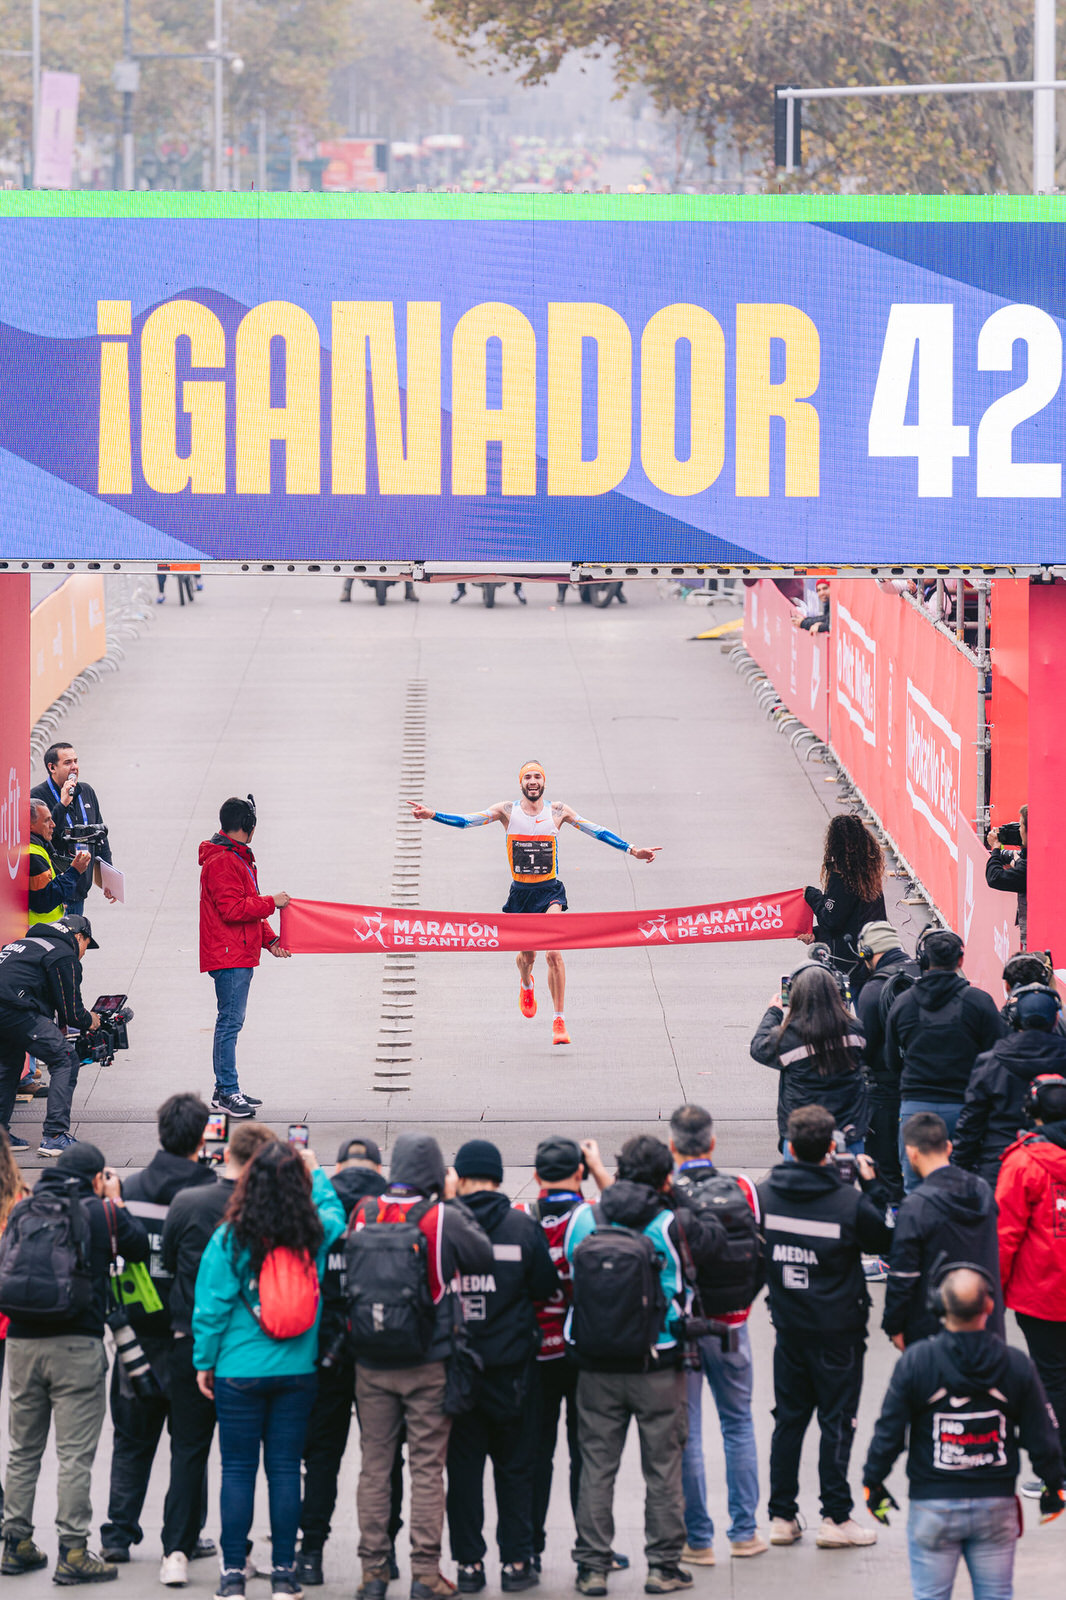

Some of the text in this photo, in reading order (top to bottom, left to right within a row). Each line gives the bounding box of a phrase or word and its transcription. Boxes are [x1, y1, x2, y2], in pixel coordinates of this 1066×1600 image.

[867, 302, 1062, 499] 42
[529, 854, 534, 864] 1
[677, 902, 782, 927] MARATÓN
[393, 919, 499, 938] MARATÓN
[678, 918, 784, 938] DE SANTIAGO
[393, 935, 500, 948] DE SANTIAGO
[772, 1244, 819, 1265] MEDIA
